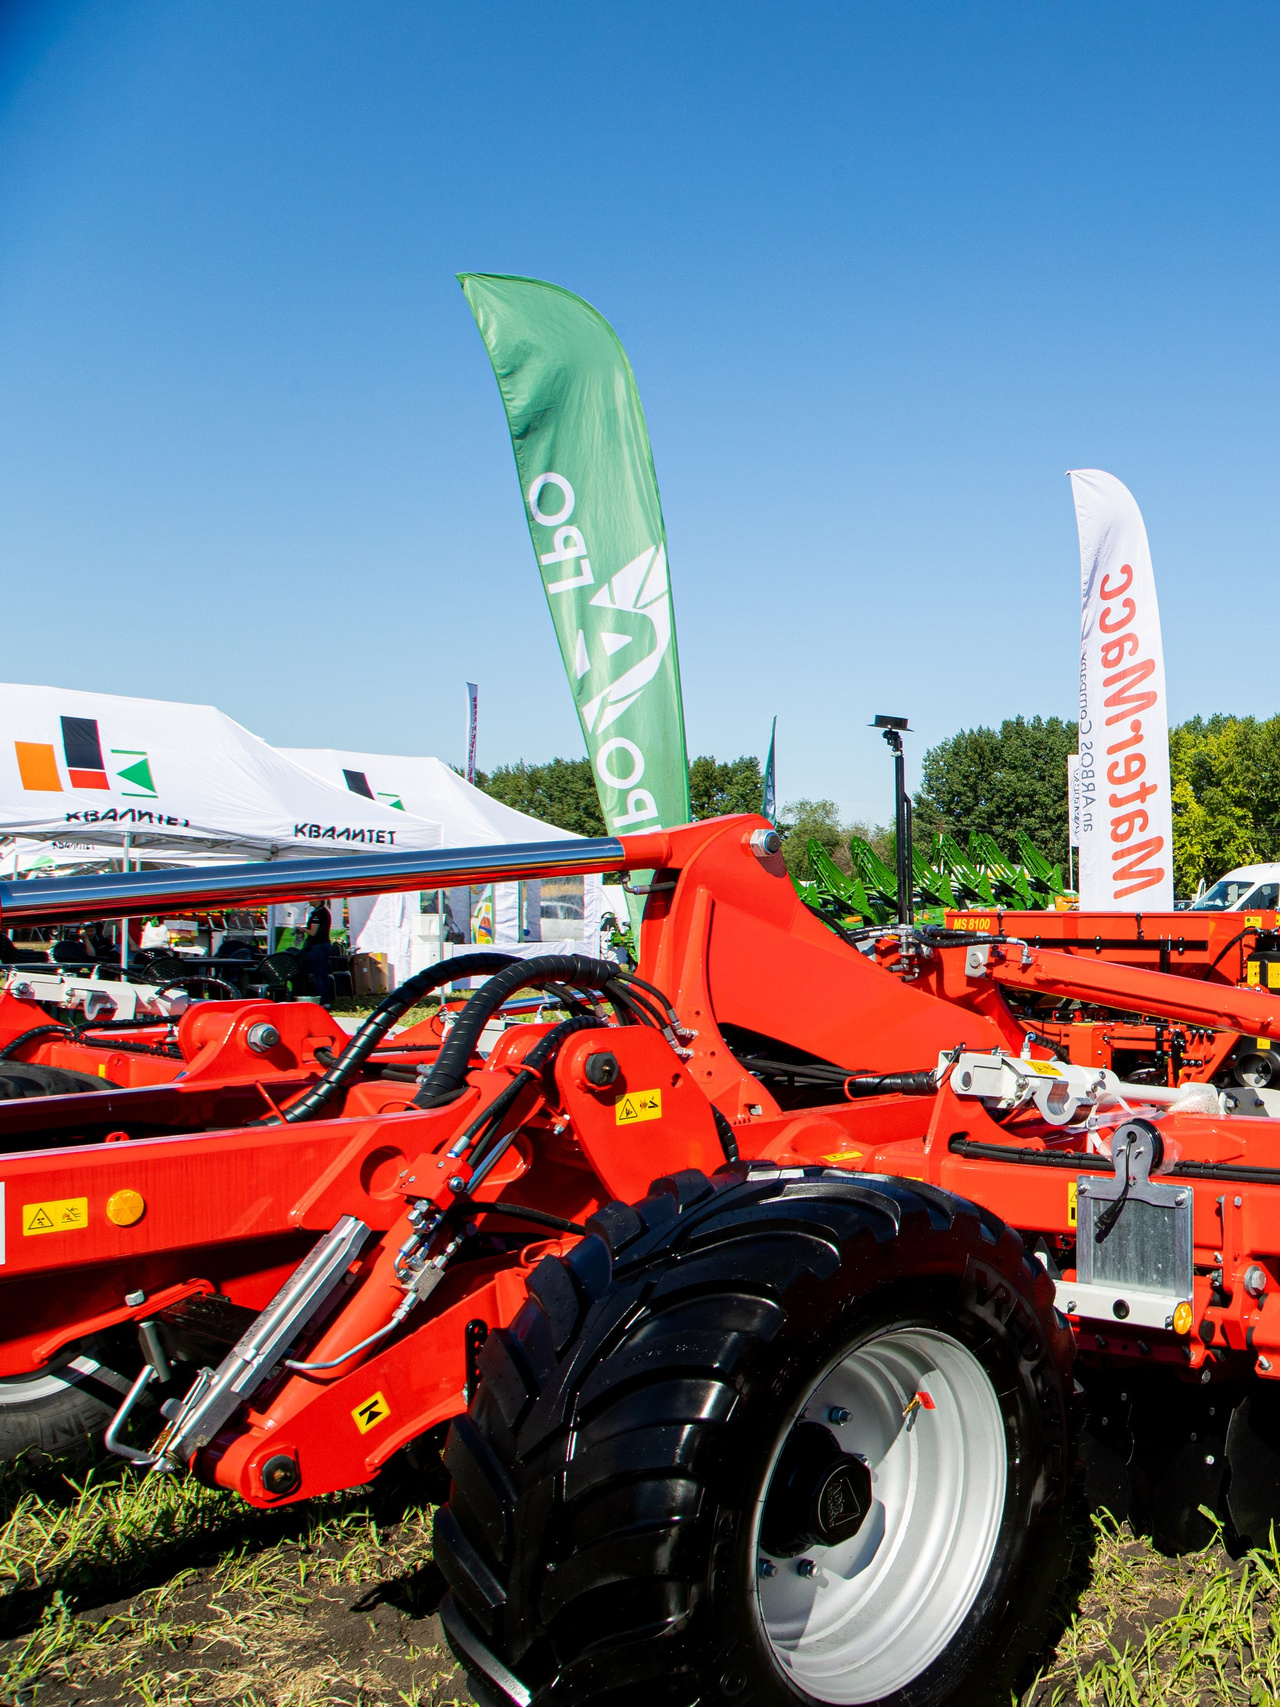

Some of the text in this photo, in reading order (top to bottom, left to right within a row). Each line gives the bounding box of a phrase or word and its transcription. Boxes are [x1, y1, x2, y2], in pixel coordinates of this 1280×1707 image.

[294, 823, 397, 844] КВАЛИТЕТ
[953, 918, 990, 930] MS 8100
